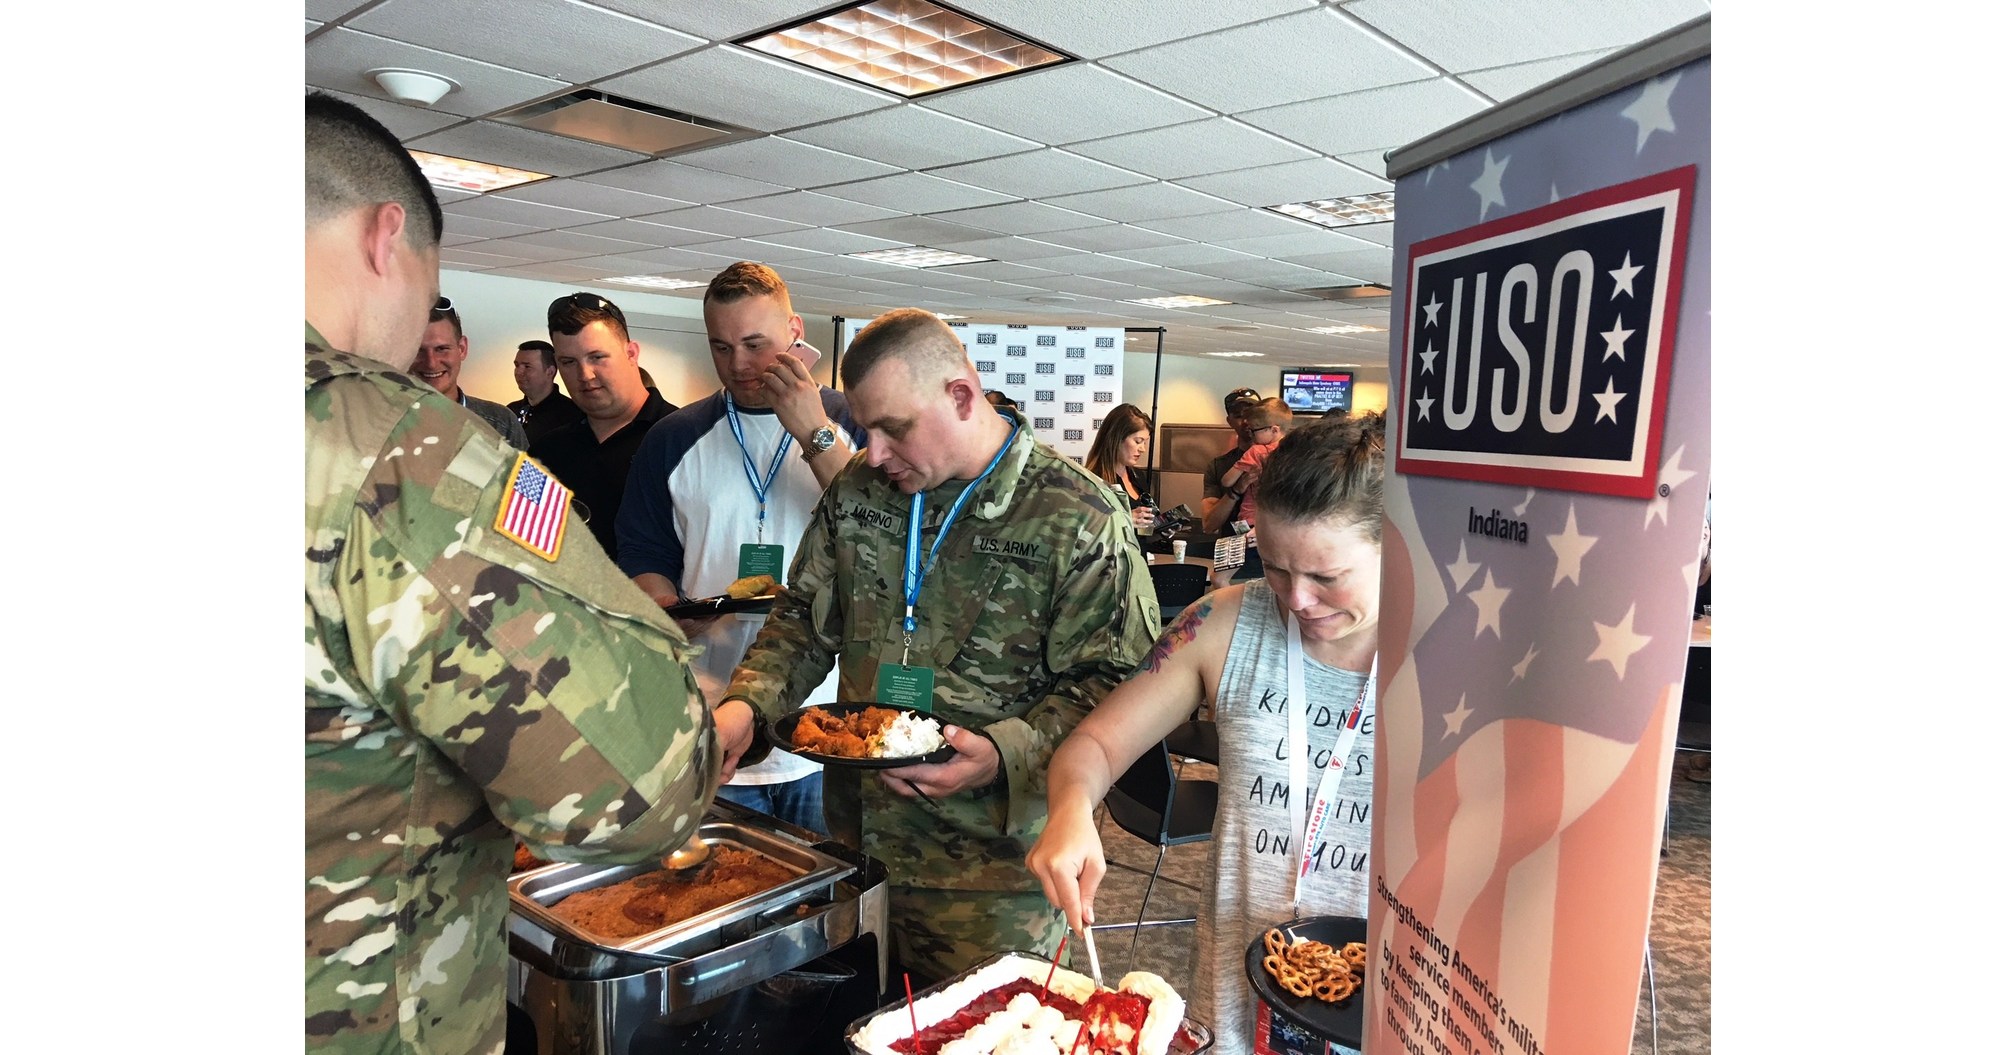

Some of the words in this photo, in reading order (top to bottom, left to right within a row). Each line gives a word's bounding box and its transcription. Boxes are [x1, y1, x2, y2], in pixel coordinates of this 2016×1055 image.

[1442, 249, 1594, 434] USO
[853, 505, 893, 529] MARINO
[1468, 506, 1529, 543] Indiana
[979, 537, 999, 552] U.S.
[1002, 540, 1040, 558] ARMY
[1258, 687, 1376, 735] KIDNE
[1275, 736, 1369, 776] LOS
[1250, 775, 1369, 824] AMIN
[1255, 828, 1290, 857] ON
[1312, 841, 1367, 872] YOU
[1303, 798, 1326, 863] Firestone
[1377, 875, 1450, 967] Strengthening
[1451, 949, 1507, 1025] America's
[1381, 968, 1389, 991] to
[1390, 979, 1423, 1037] family,
[1383, 939, 1394, 971] by
[1396, 954, 1439, 1022] keeping
[1441, 1006, 1472, 1055] them
[1409, 945, 1450, 996] service
[1452, 986, 1504, 1055] members
